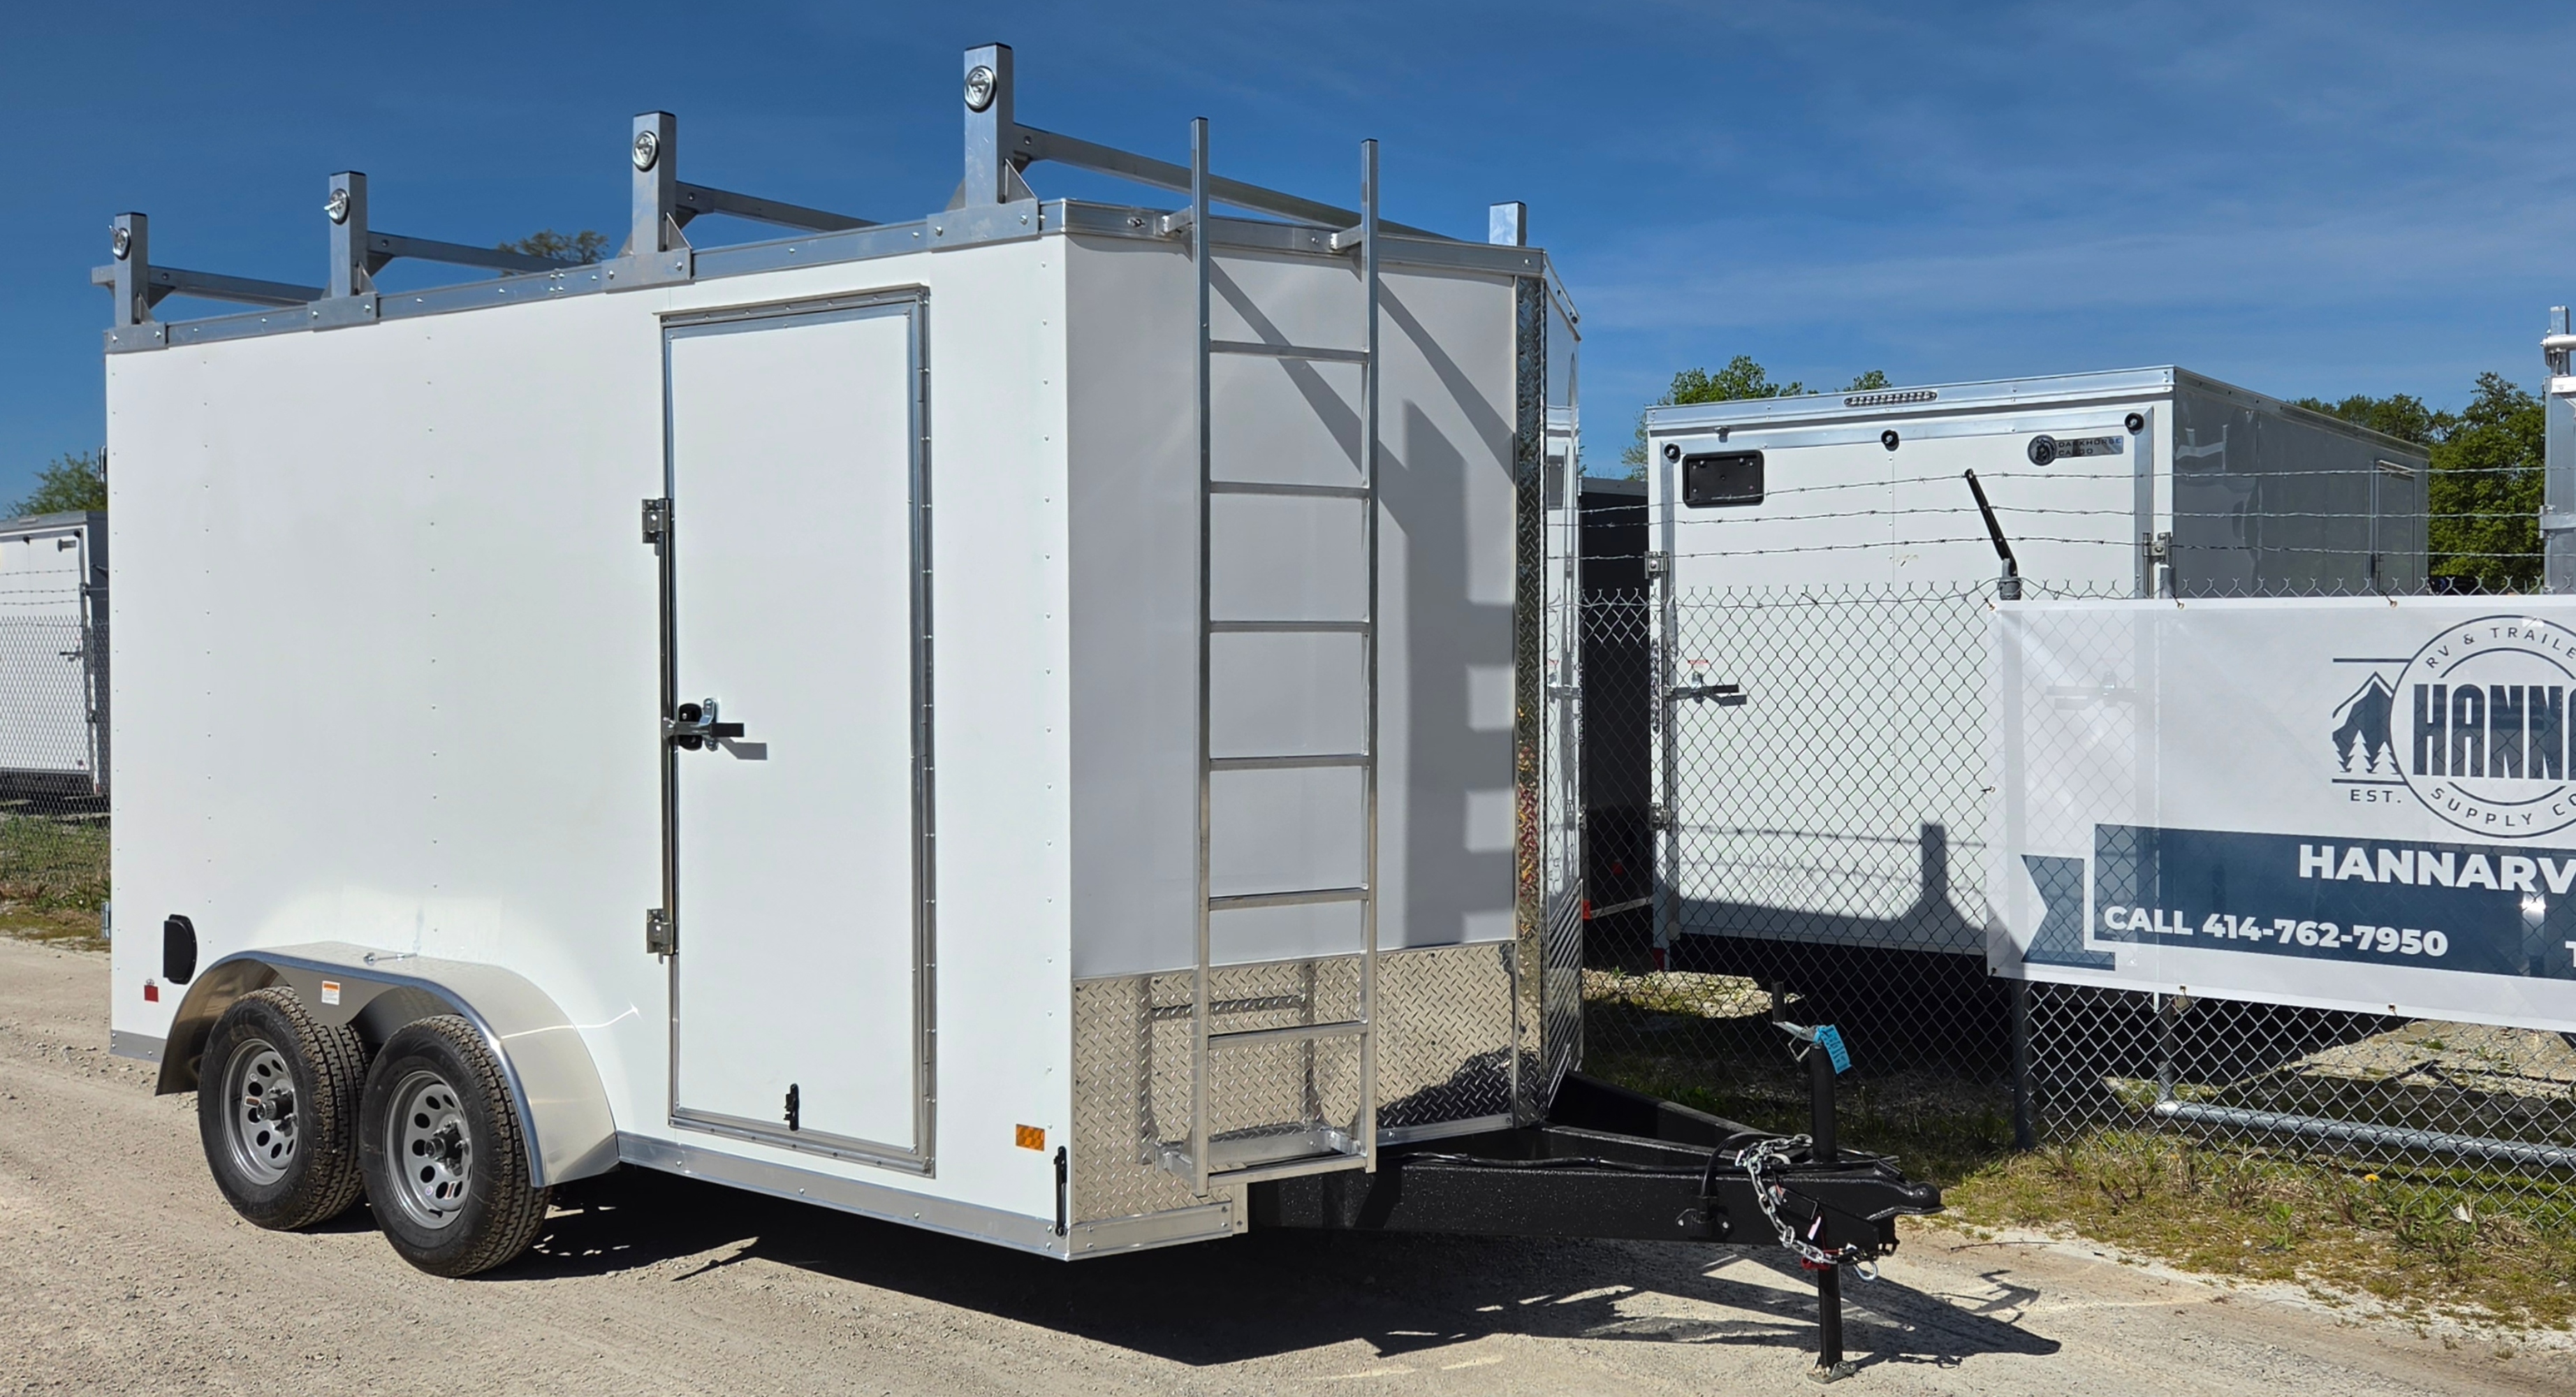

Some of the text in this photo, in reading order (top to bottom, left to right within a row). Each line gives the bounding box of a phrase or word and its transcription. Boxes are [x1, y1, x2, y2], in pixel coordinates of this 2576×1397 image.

[2058, 438, 2121, 448] DAKHORSE
[2425, 627, 2576, 668] RV & TRAILE
[2413, 684, 2576, 780] HANN
[2350, 789, 2401, 803] EST.
[2430, 787, 2533, 827] SUPPLY
[2299, 844, 2576, 894] HANNARV
[2104, 905, 2449, 957] CALL 414-762-7950
